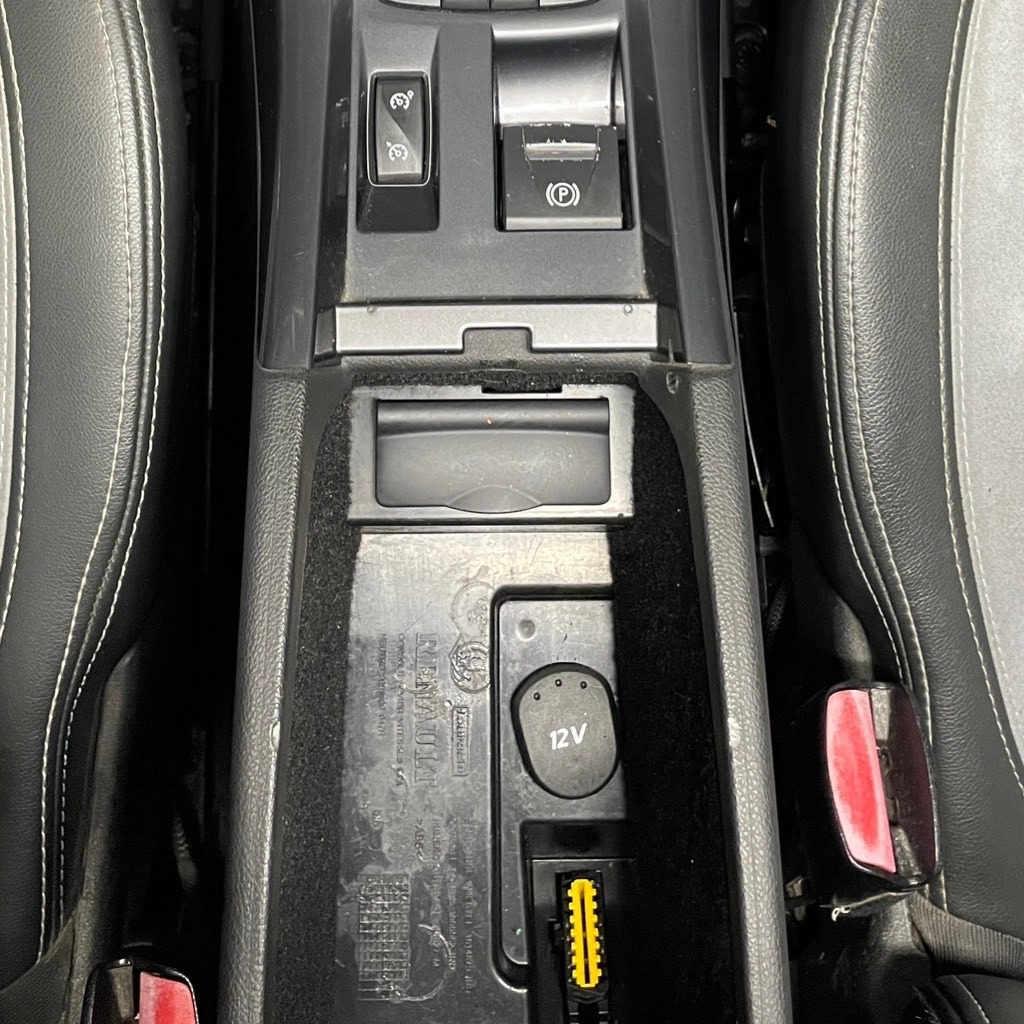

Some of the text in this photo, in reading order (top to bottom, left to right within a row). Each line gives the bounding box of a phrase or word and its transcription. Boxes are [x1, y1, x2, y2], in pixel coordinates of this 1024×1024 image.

[558, 187, 569, 202] P
[414, 632, 437, 788] RENAULT
[549, 723, 587, 751] 12V
